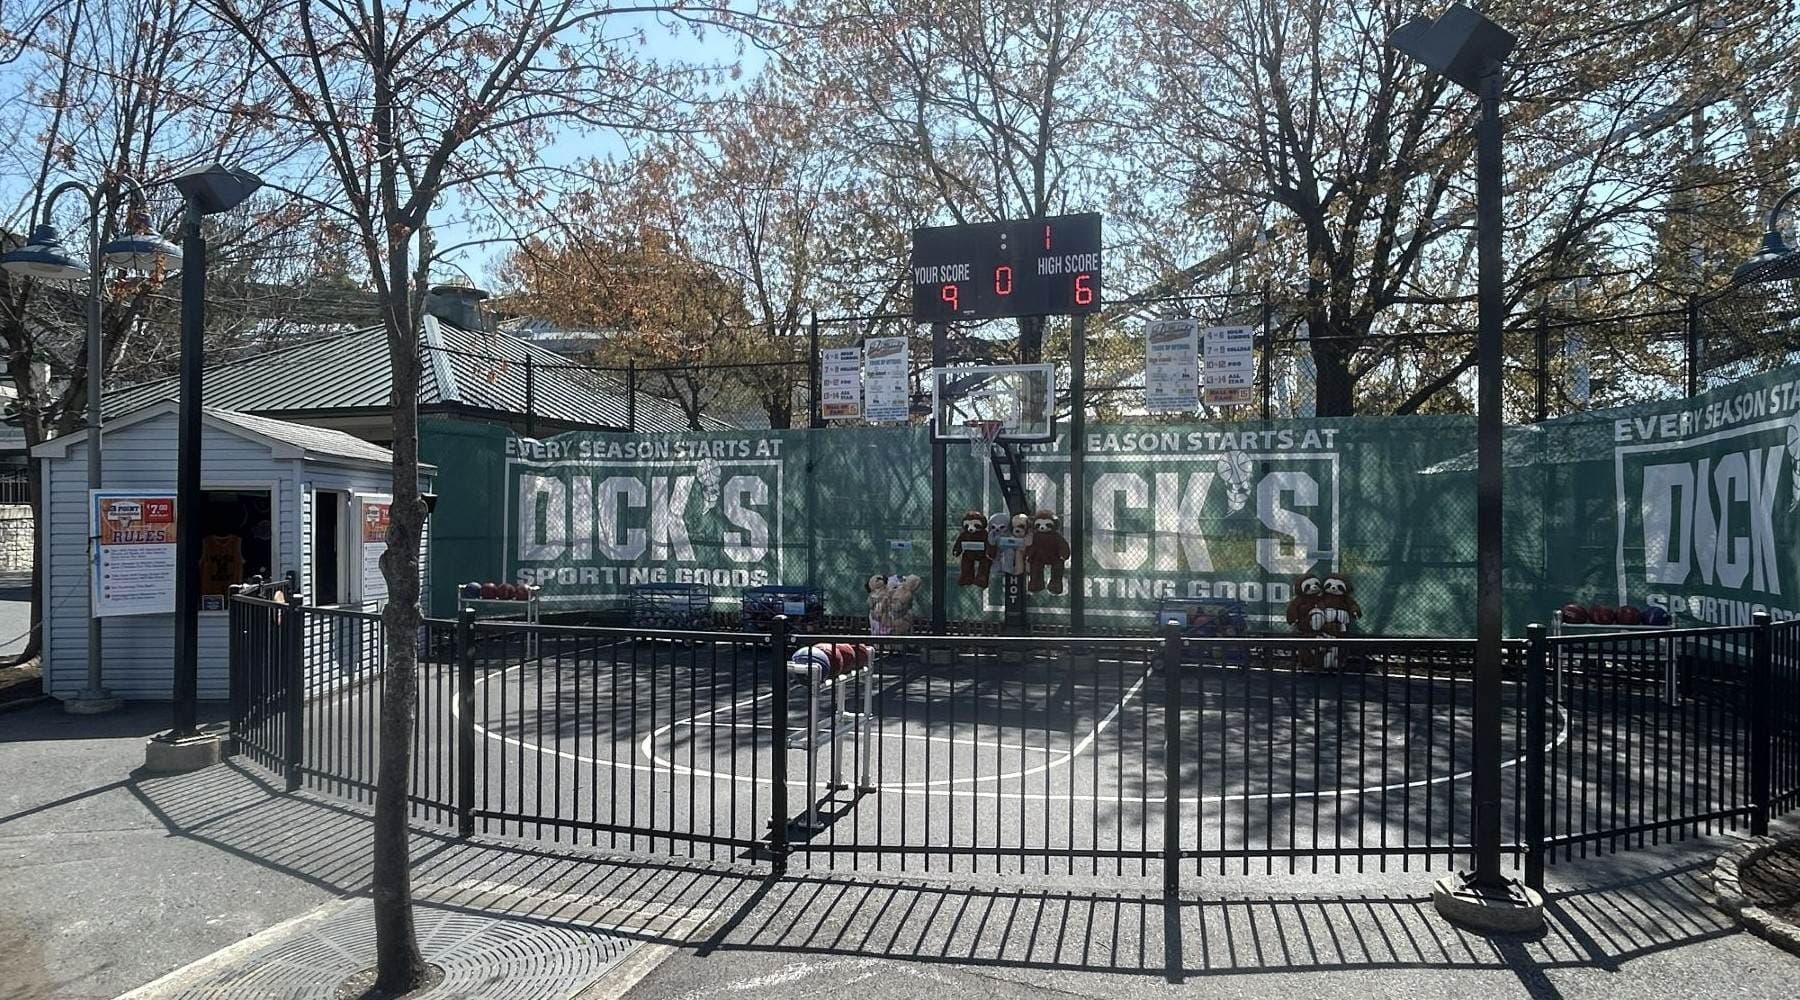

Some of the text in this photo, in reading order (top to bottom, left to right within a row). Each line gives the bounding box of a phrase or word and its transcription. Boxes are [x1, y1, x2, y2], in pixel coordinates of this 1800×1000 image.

[1044, 225, 1051, 250] 1
[914, 264, 970, 284] YOUR SCORE
[1038, 253, 1098, 275] HIGH SCORE
[995, 266, 1012, 295] 0
[1075, 275, 1092, 305] 6
[942, 285, 958, 311] 9
[1614, 405, 1703, 442] EVERY
[1704, 388, 1767, 431] SEASON
[505, 437, 783, 459] EVERY SEASON STARTS AT
[1088, 433, 1179, 451] EASON
[1187, 429, 1295, 451] STARTS
[1301, 428, 1340, 449] AT
[518, 457, 769, 563] DICK'S
[113, 530, 166, 542] RULES
[516, 567, 768, 588] SPORTING GOODS
[1187, 580, 1296, 602] GOOD
